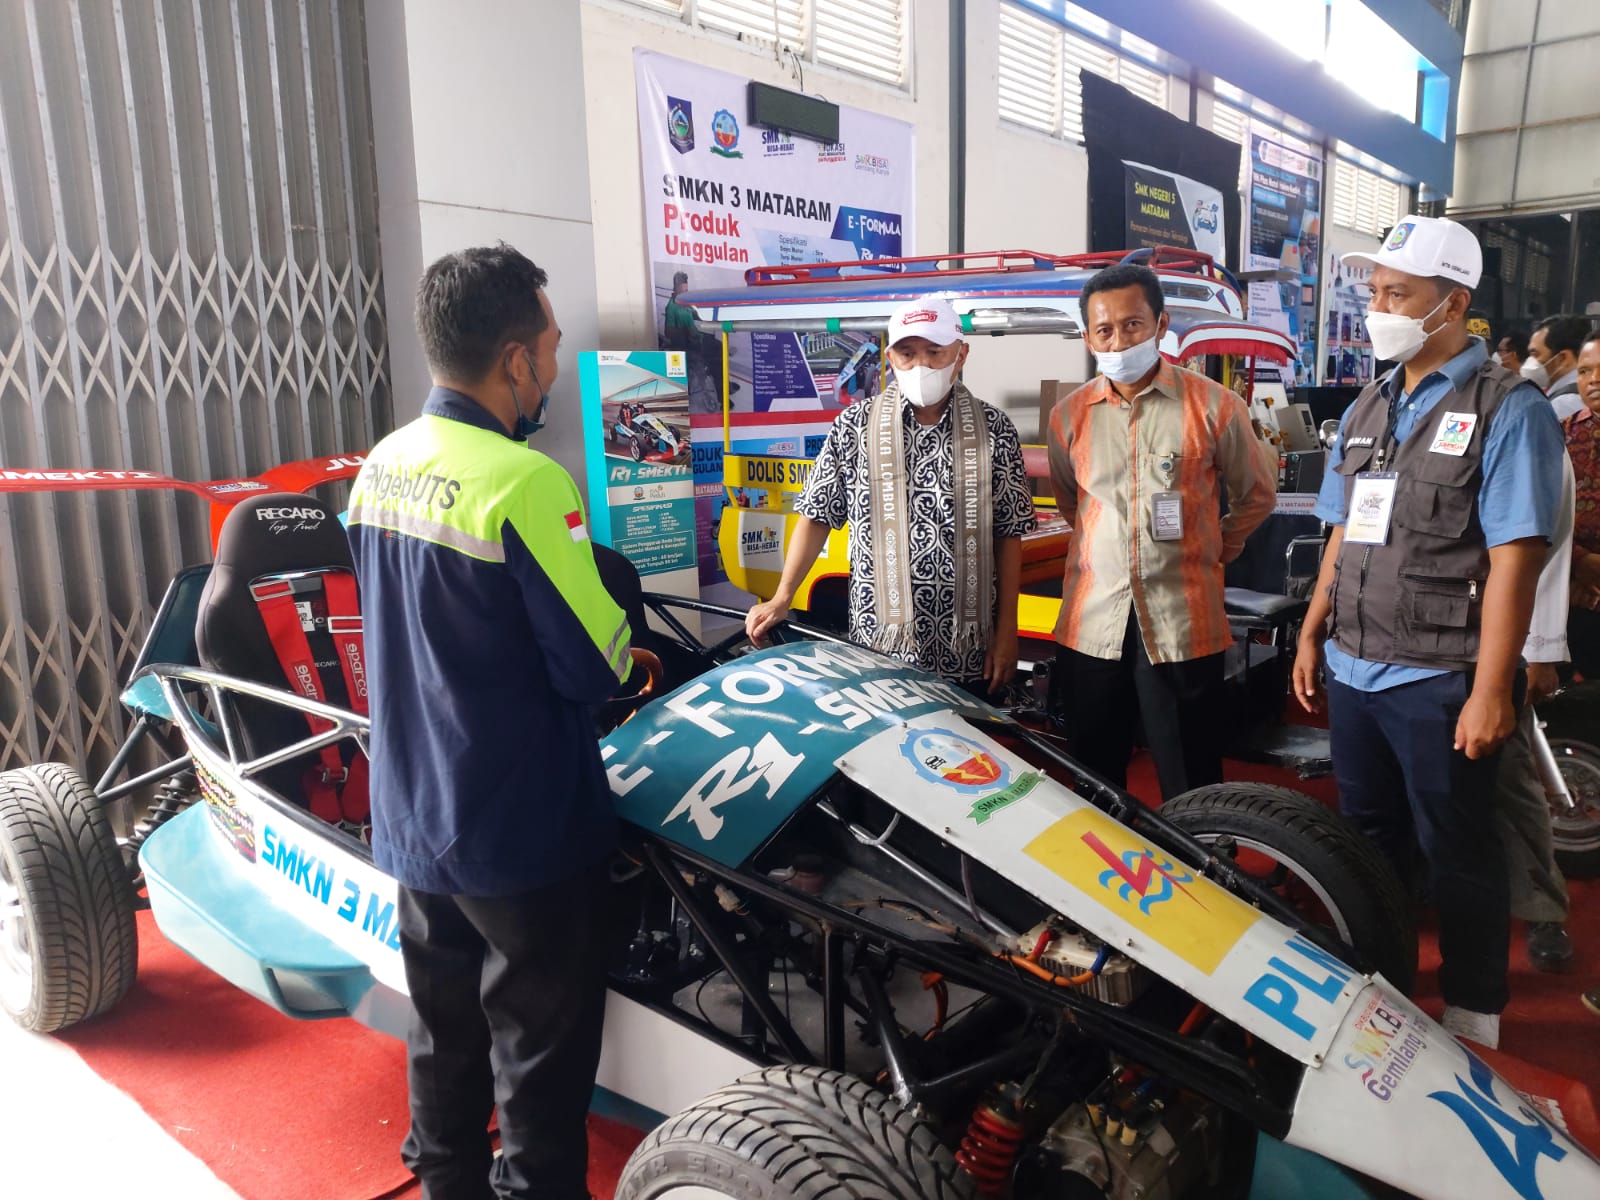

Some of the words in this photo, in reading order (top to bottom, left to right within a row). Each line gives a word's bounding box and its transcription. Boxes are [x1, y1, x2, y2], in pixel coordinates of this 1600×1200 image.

[662, 173, 724, 206] SMKN
[730, 185, 741, 208] 3
[746, 188, 832, 222] MATARAM
[1140, 201, 1170, 220] MATARAM
[663, 203, 741, 238] Produk
[664, 234, 749, 264] Unggulan
[0, 470, 158, 480] MEKTI
[747, 460, 785, 484] DOLIS
[788, 462, 813, 485] SM
[881, 462, 896, 521] LOMBOK
[964, 447, 978, 530] MANDALIKA
[255, 507, 326, 521] RECARO
[268, 519, 289, 535] Top
[742, 530, 763, 545] SMK
[747, 541, 779, 552] BISA-HEBAT
[976, 796, 1009, 813] SMKN
[261, 823, 336, 906] SMKN
[336, 878, 361, 923] 3
[1243, 934, 1357, 1042] PLN
[1366, 1032, 1428, 1102] Gemilang
